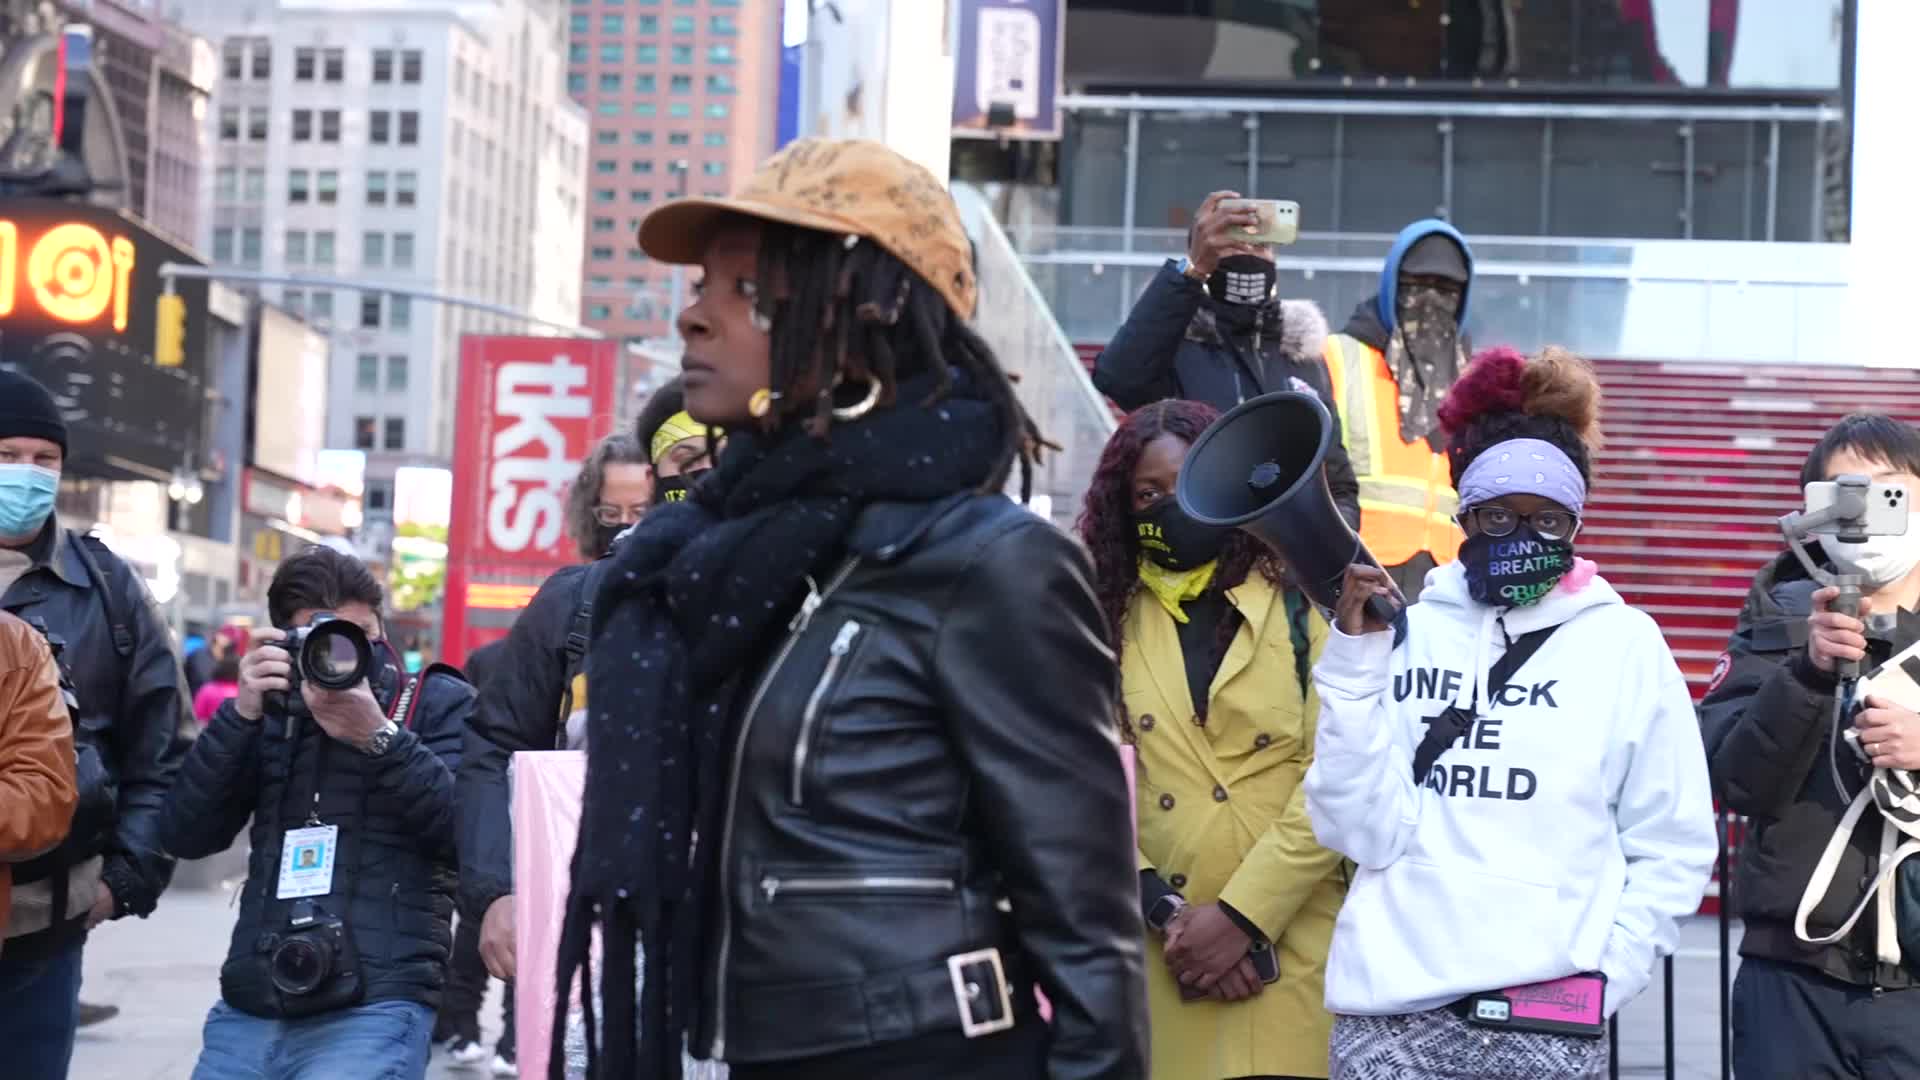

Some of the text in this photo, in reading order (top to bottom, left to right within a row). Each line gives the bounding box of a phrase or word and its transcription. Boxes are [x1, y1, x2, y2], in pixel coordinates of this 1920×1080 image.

[488, 355, 592, 552] tkts
[1489, 555, 1561, 576] BREATHE
[1393, 667, 1559, 709] UNFCK
[1424, 763, 1537, 801] ORLD
